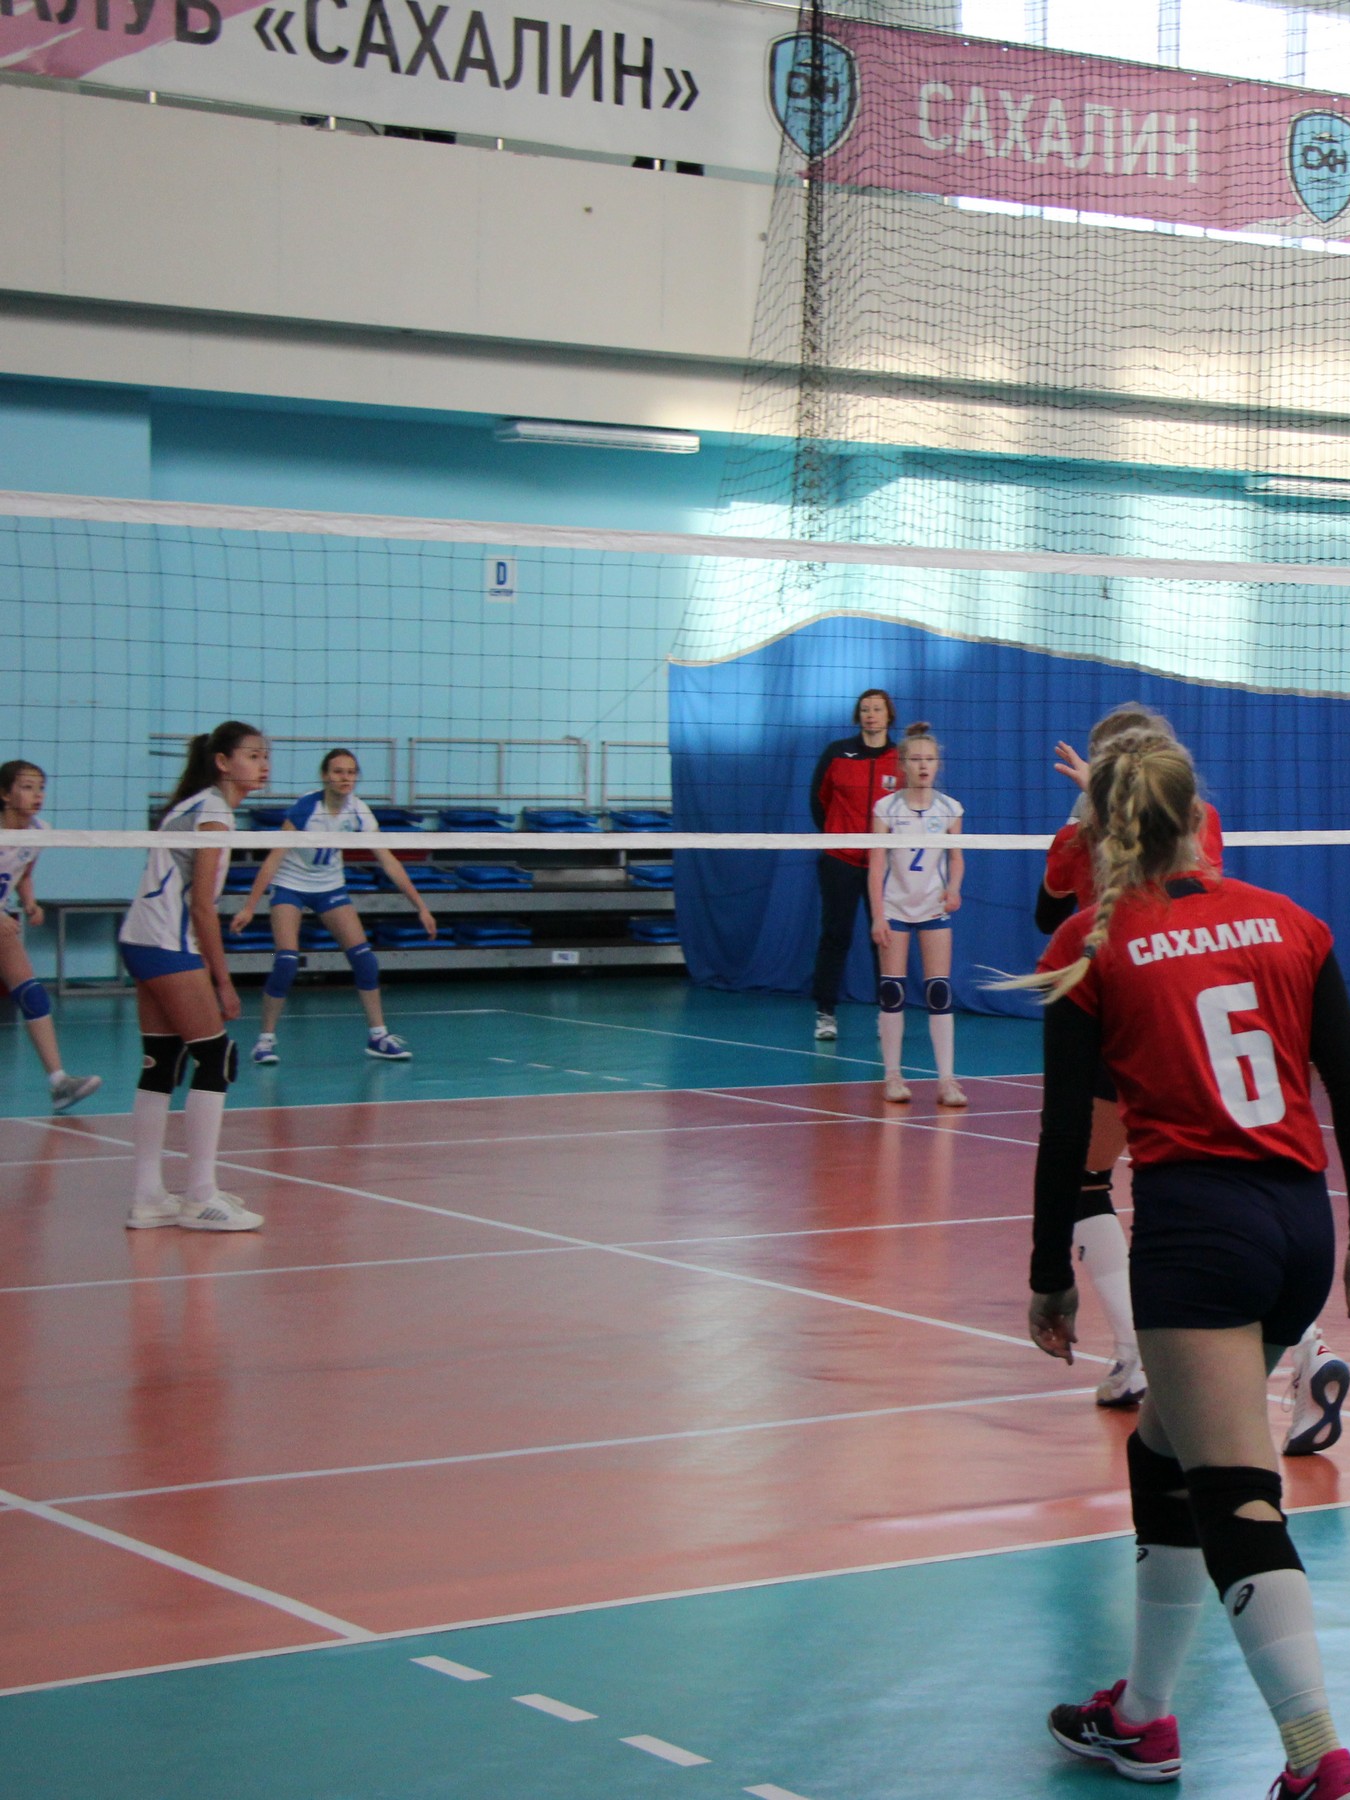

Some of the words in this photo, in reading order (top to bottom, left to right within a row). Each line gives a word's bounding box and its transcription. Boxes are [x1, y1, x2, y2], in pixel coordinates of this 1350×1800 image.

[917, 81, 1199, 184] САХАЛИН
[496, 561, 507, 585] D
[909, 848, 926, 872] 2
[1127, 918, 1283, 966] САХАЛИН
[1196, 981, 1286, 1128] 6
